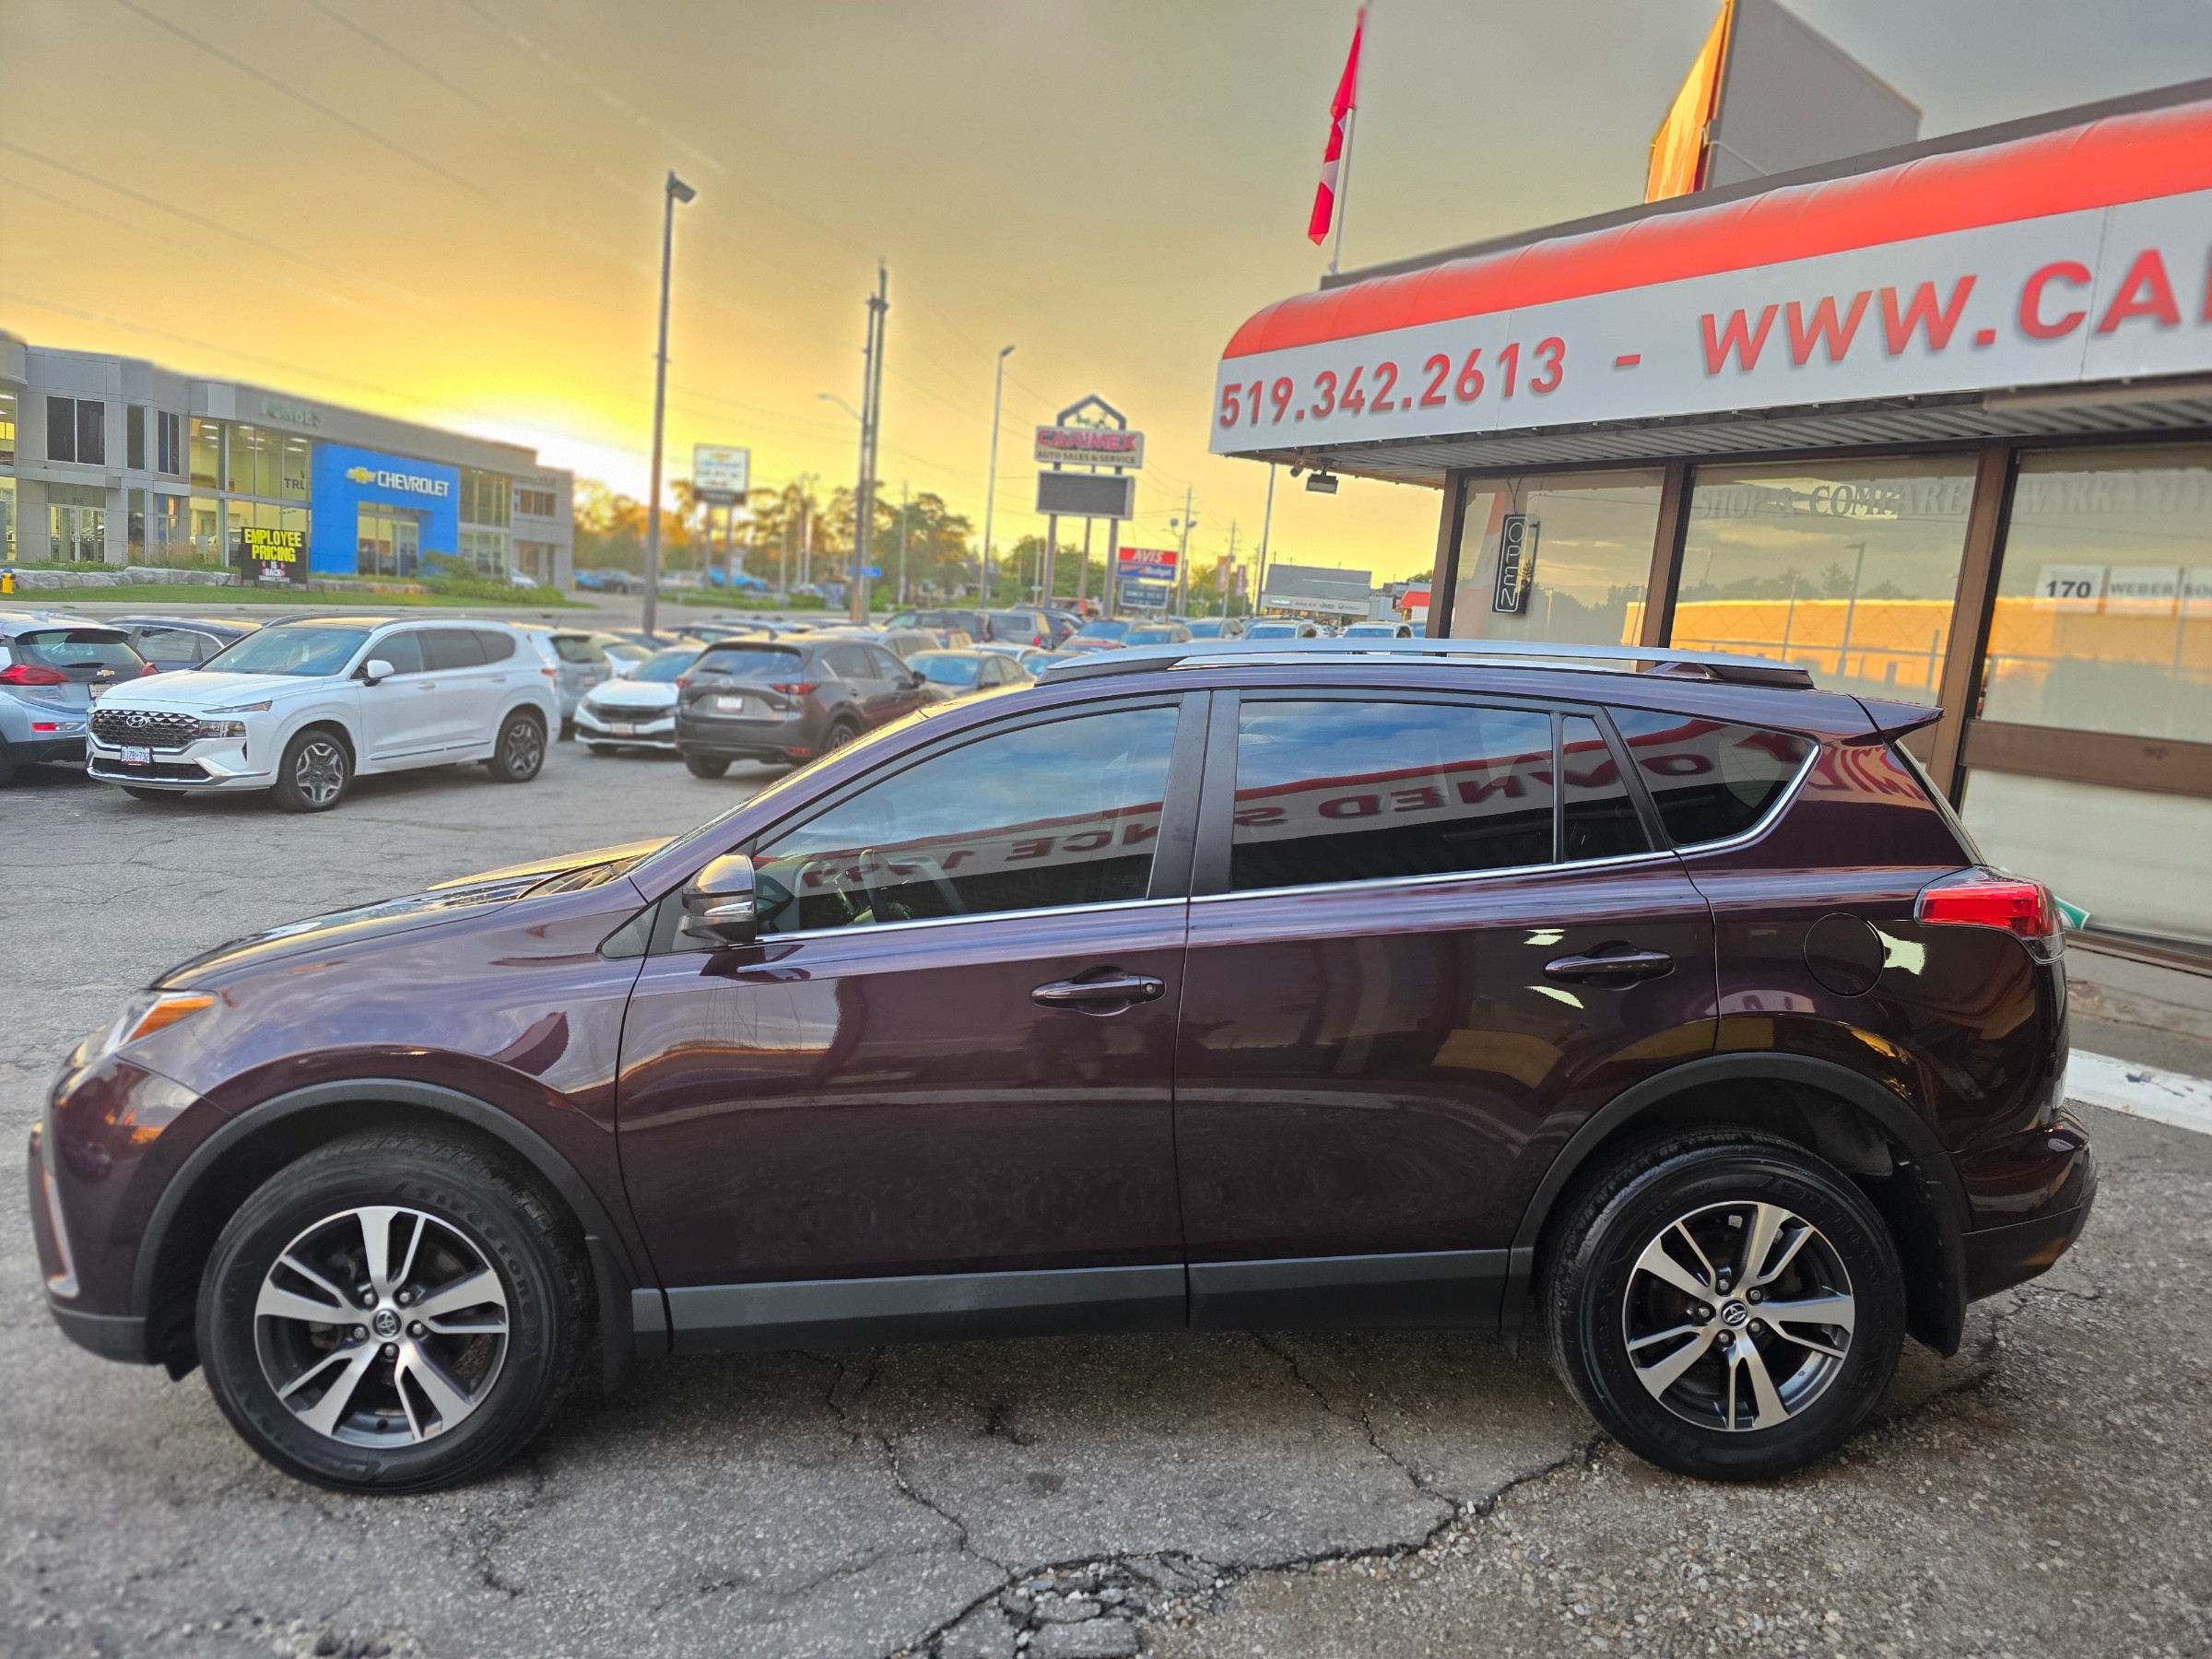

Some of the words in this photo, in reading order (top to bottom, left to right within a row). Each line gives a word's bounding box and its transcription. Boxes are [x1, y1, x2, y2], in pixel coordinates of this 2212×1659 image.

[1219, 335, 1567, 429] 519.342.2613
[1700, 247, 2212, 375] WWW.CA
[1037, 429, 1137, 453] CARIMEX
[1038, 450, 1061, 460] AUTO
[1063, 452, 1089, 462] SALES
[1100, 453, 1135, 464] SERVICE
[377, 468, 450, 499] CHEVROLET
[1694, 487, 1764, 519] SHOP
[1809, 480, 1969, 517] COMPARE
[244, 528, 302, 547] EMPLOYEE
[252, 544, 297, 563] PRICING
[1132, 549, 1164, 563] AVIS
[265, 568, 282, 577] BACK
[1500, 522, 1524, 607] OPEN
[2045, 580, 2092, 599] 170
[2111, 582, 2174, 597] WEBER
